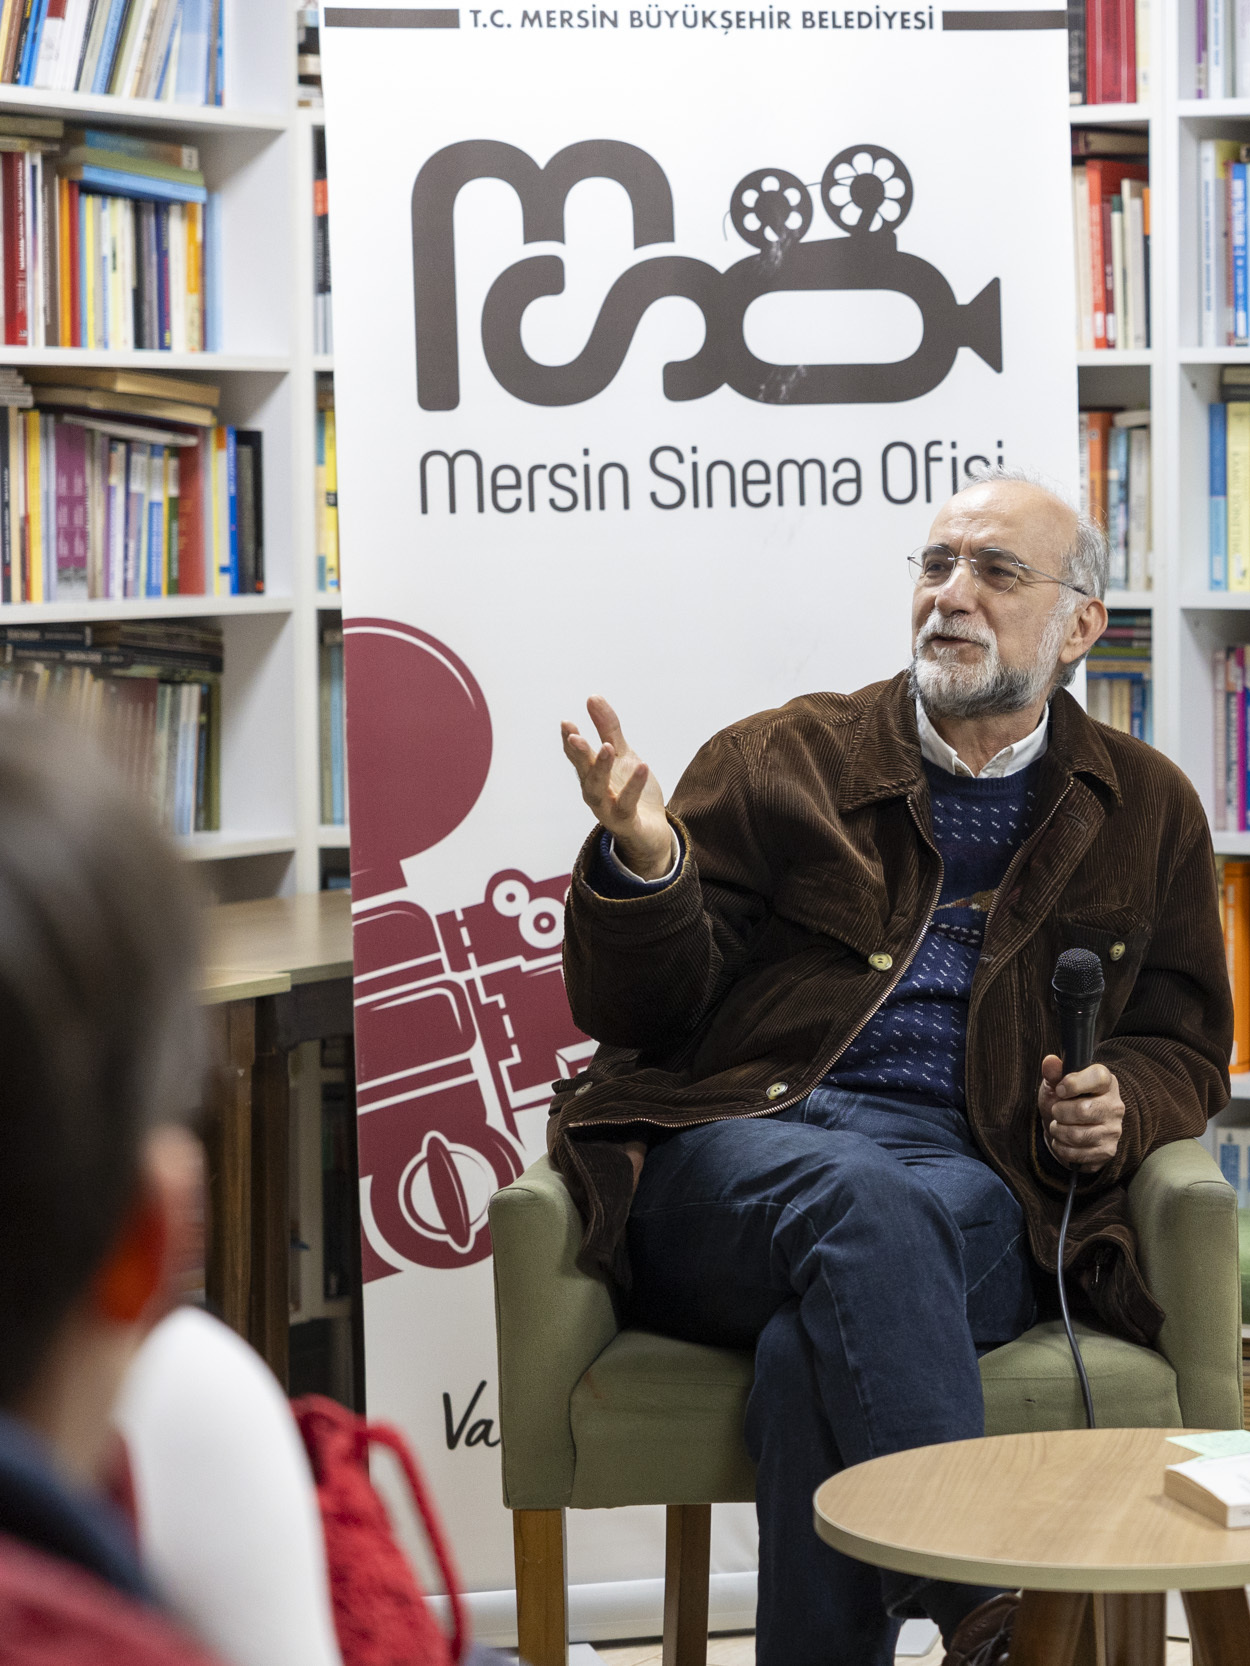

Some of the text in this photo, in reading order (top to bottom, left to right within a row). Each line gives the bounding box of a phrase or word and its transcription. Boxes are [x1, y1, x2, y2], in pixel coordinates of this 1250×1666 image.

[469, 4, 934, 35] T.C. MERSİN BÜYÜKŞEHİR BELEDİYESİ
[420, 448, 630, 514] Mersin
[649, 446, 862, 510] Sinema
